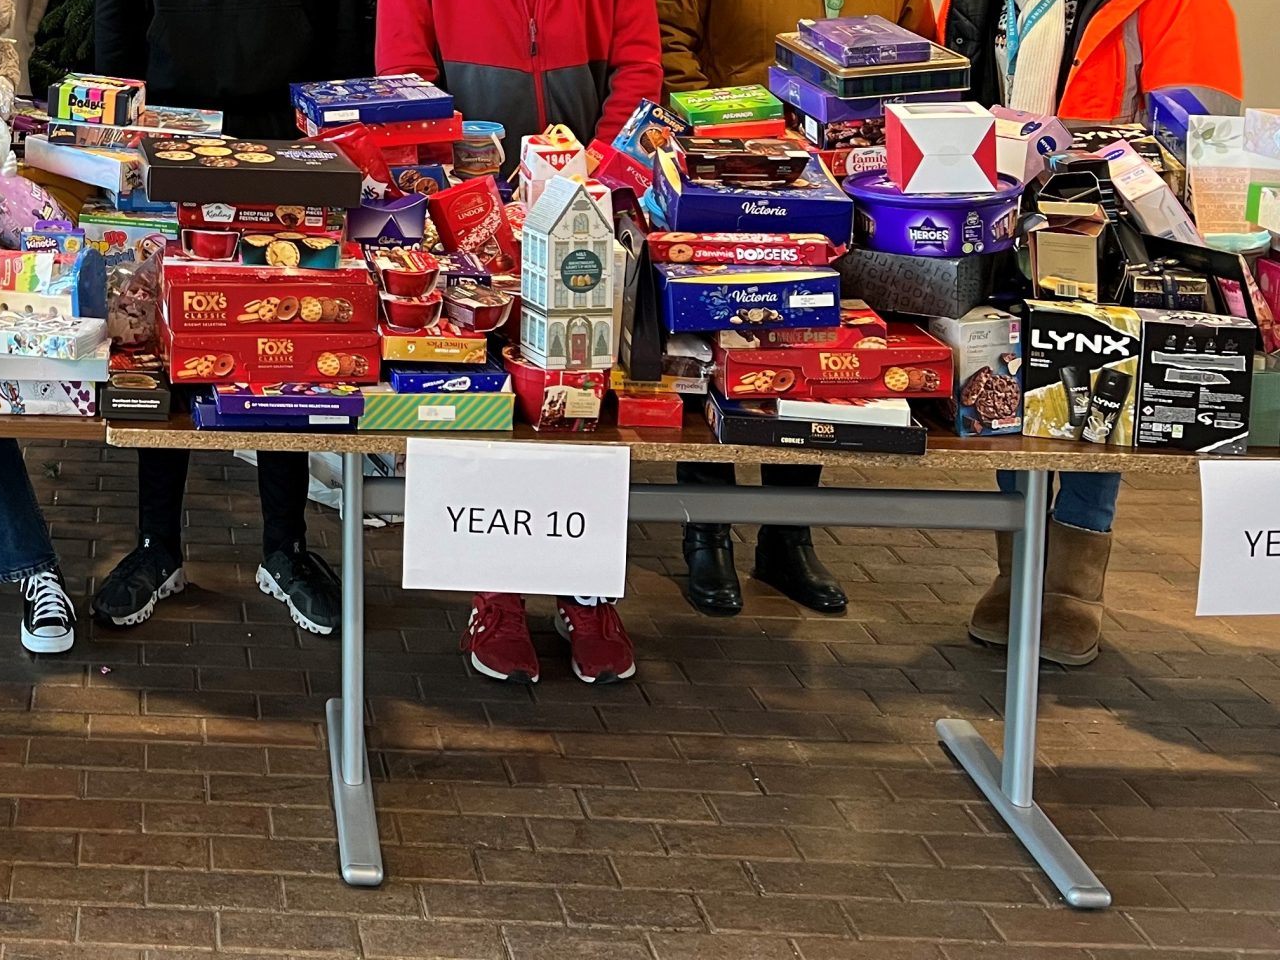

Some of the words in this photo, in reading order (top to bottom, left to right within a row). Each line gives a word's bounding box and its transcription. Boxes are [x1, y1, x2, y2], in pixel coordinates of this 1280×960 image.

[652, 107, 684, 132] Orange
[545, 154, 571, 166] 1946
[205, 208, 232, 220] Kipling
[458, 206, 484, 220] LINDOR
[741, 200, 788, 217] Victoria
[909, 229, 949, 241] HEROES
[26, 238, 57, 249] Kinetic
[695, 250, 734, 259] Jammie
[736, 247, 799, 262] DODGERS
[183, 292, 228, 312] FOX'S
[732, 289, 778, 304] Victoria
[769, 332, 776, 343] 6
[803, 332, 837, 343] PIES
[1031, 330, 1131, 356] LYNX
[257, 338, 294, 355] FOX'S
[819, 352, 860, 371] FOX'S
[244, 401, 251, 409] 6
[1093, 396, 1120, 409] LYNX
[446, 506, 532, 536] YEAR
[546, 511, 586, 538] 10
[1244, 530, 1280, 558] YE
